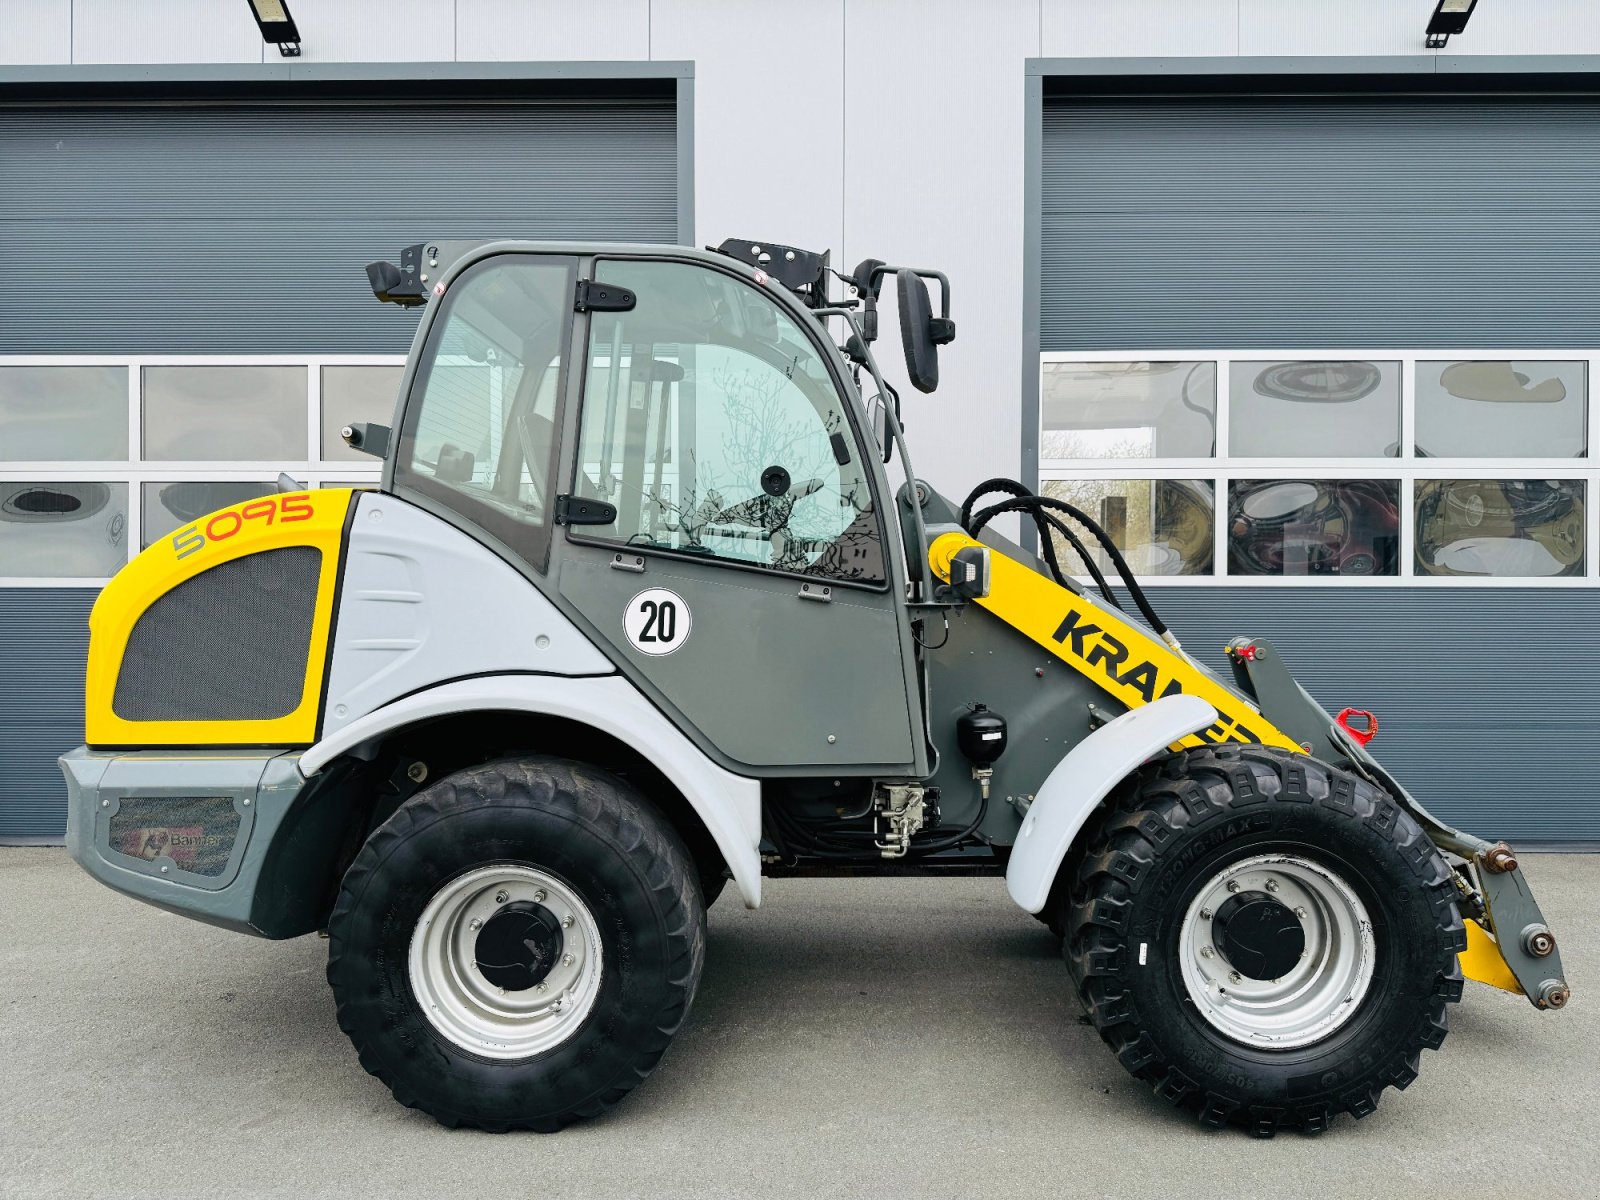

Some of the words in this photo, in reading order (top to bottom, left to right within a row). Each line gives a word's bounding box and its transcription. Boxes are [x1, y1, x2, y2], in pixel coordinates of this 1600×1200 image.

[173, 495, 314, 560] 5095
[639, 600, 676, 642] 20
[1052, 609, 1262, 743] KRAE
[171, 833, 221, 846] Banner
